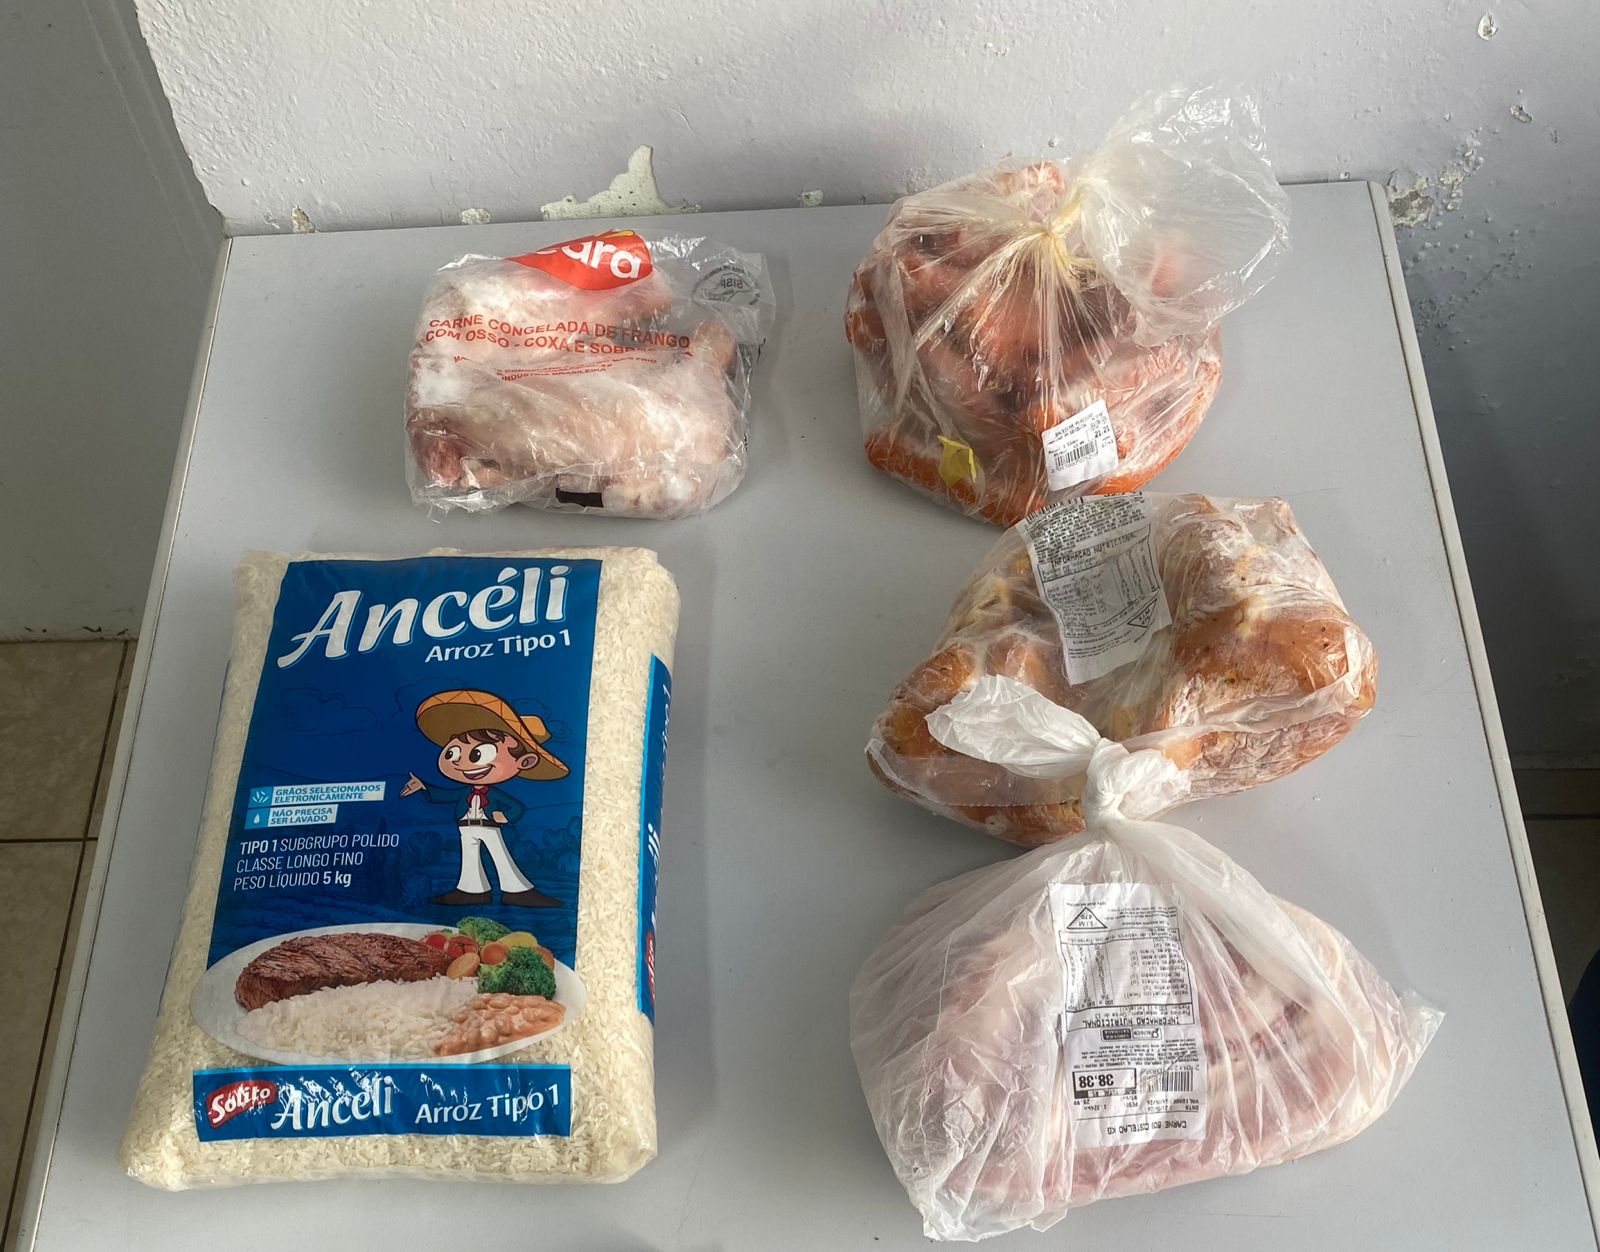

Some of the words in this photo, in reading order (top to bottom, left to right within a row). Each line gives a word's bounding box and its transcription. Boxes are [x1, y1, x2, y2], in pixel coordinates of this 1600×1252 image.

[536, 240, 641, 279] ara
[425, 328, 461, 342] COM
[465, 329, 510, 348] OSSO
[524, 335, 570, 352] COXA
[574, 339, 585, 354] E
[429, 314, 483, 329] CARNE
[488, 318, 590, 337] CONGELADA
[595, 323, 617, 339] DE
[622, 327, 690, 348] FRANGO
[277, 565, 572, 669] Ancéli
[424, 643, 494, 663] Arroz
[498, 634, 556, 657] Tipo
[559, 629, 571, 646] 1
[274, 793, 364, 804] ELETRONICAMENTE
[275, 786, 309, 796] GRÃOS
[310, 784, 381, 795] SELECIONADOS
[270, 816, 288, 825] SER
[289, 814, 328, 824] LAVADO
[271, 807, 293, 818] NÃO
[295, 807, 333, 817] PRECISA
[240, 840, 268, 855] TIPO
[271, 839, 277, 852] 1
[280, 834, 348, 852] SUBGRUPO
[351, 833, 400, 848] POLIDO
[236, 856, 284, 873] CLASSE
[286, 852, 330, 869] LONGO
[333, 851, 364, 866] FINO
[233, 874, 266, 891] PESO
[269, 871, 320, 888] LÍQUIDO
[322, 871, 332, 885] 5
[334, 870, 352, 888] kg
[1082, 1017, 1133, 1028] NUTRICIONAL
[211, 1084, 271, 1124] Solito
[414, 1102, 482, 1124] Arroz
[486, 1092, 544, 1123] Tipo
[548, 1083, 559, 1106] 1
[1164, 1120, 1186, 1128] CARNE
